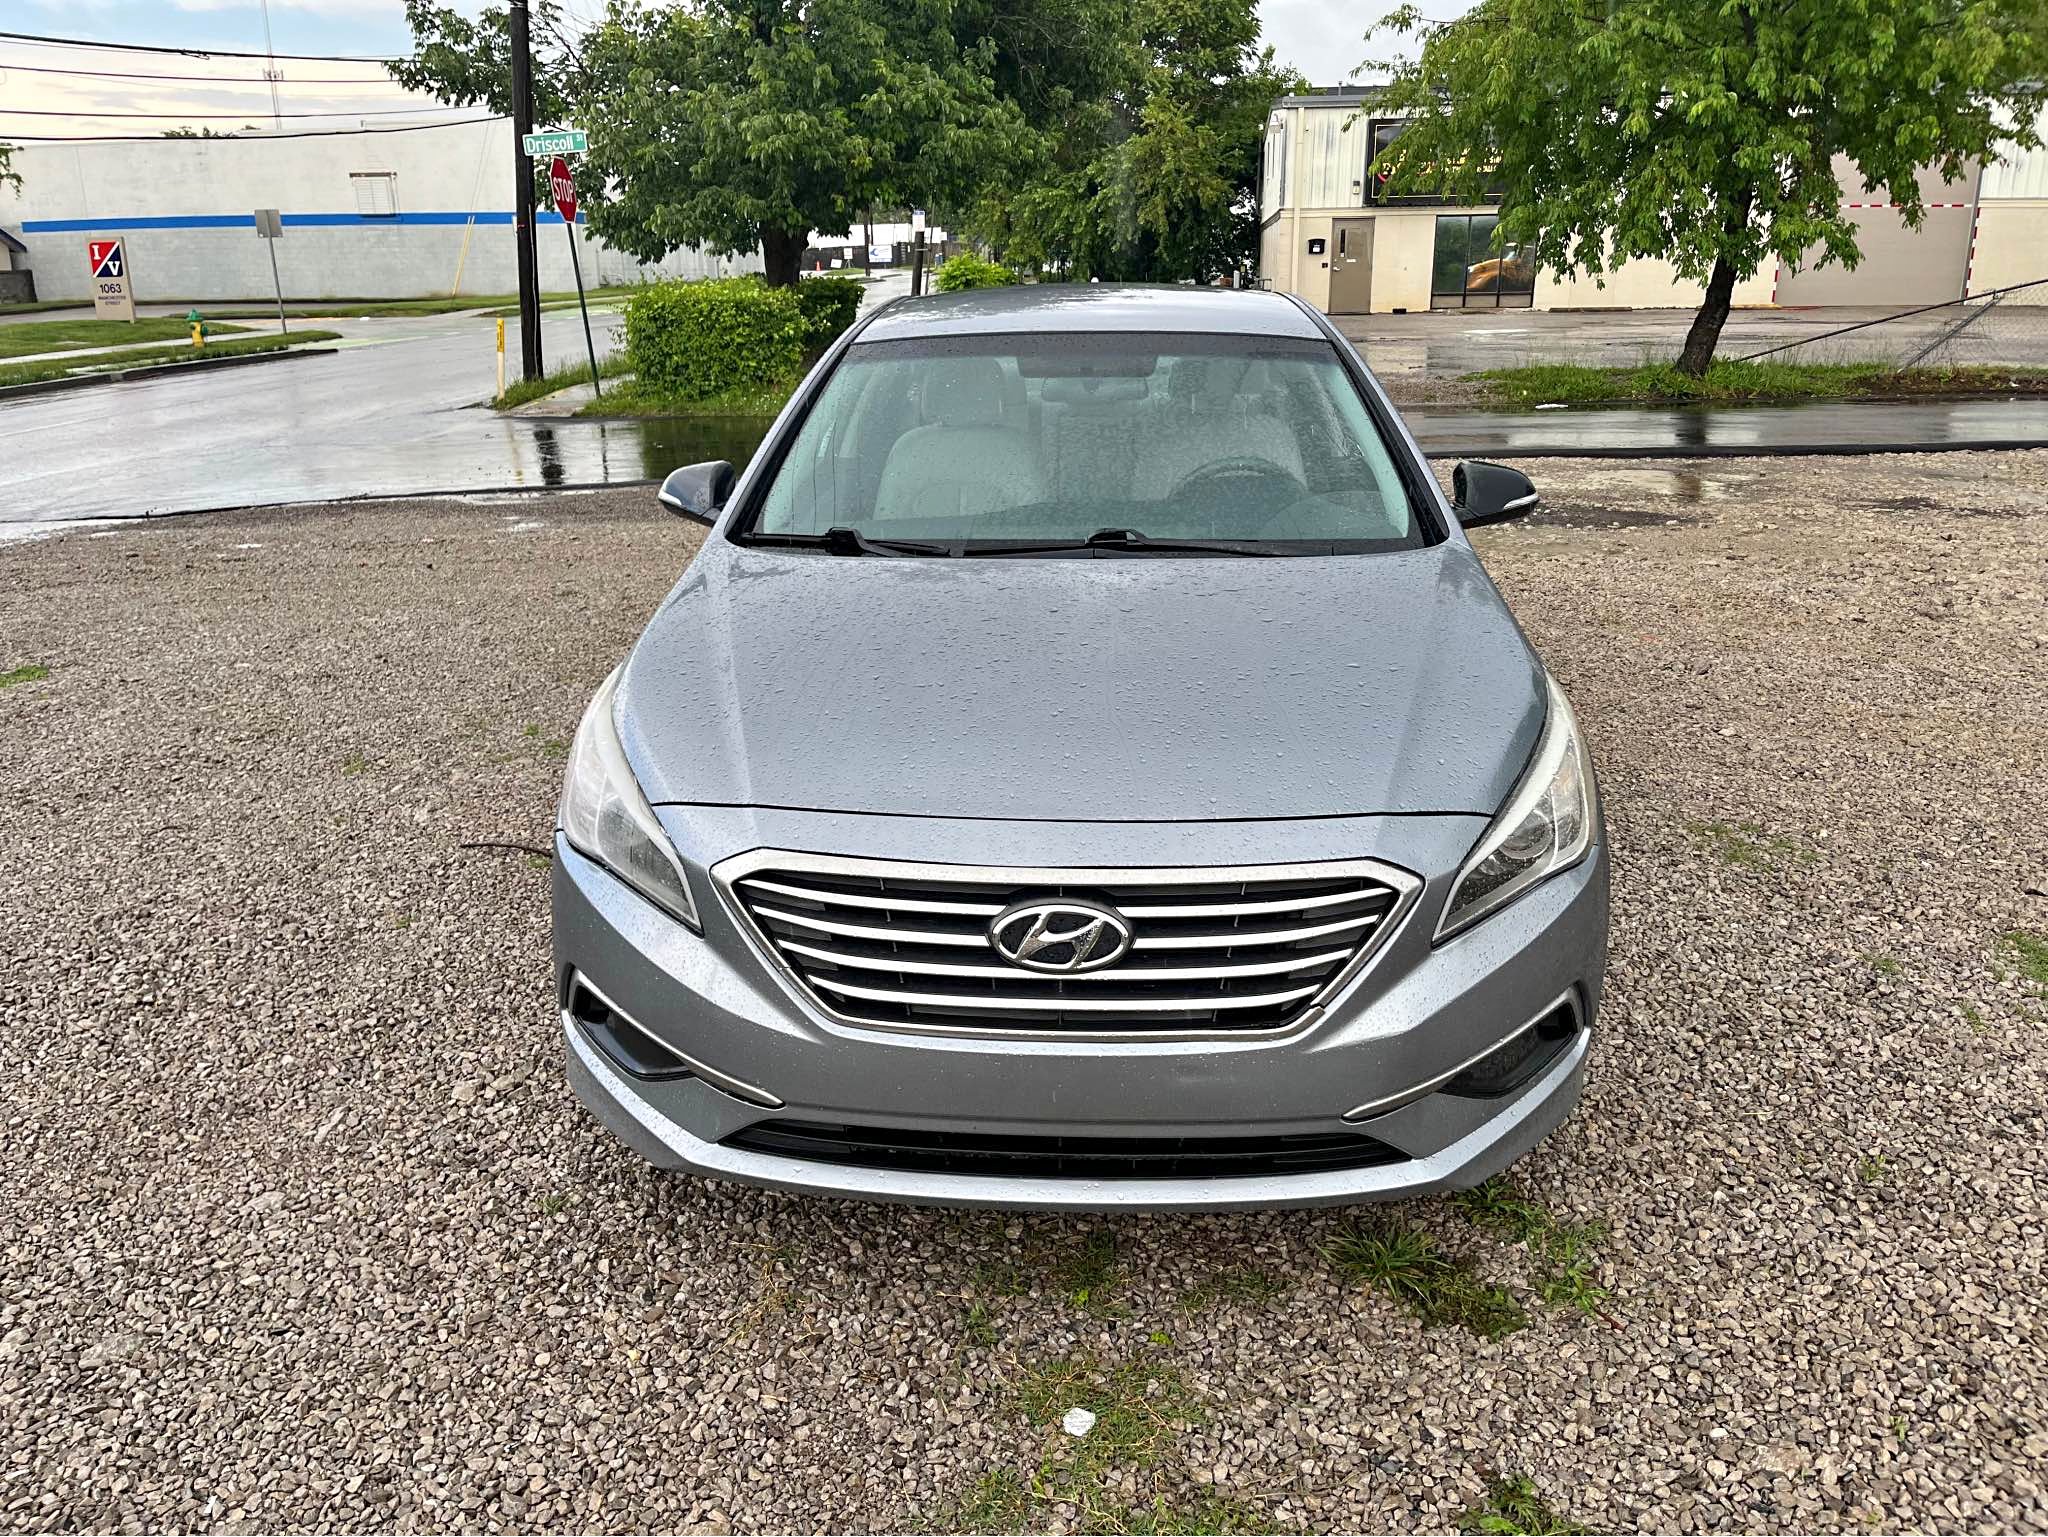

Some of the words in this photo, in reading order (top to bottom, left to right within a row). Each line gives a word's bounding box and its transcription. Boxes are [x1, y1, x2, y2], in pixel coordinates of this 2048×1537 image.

[526, 135, 574, 153] Driscoll
[553, 177, 574, 203] STOP
[99, 283, 121, 294] 1063
